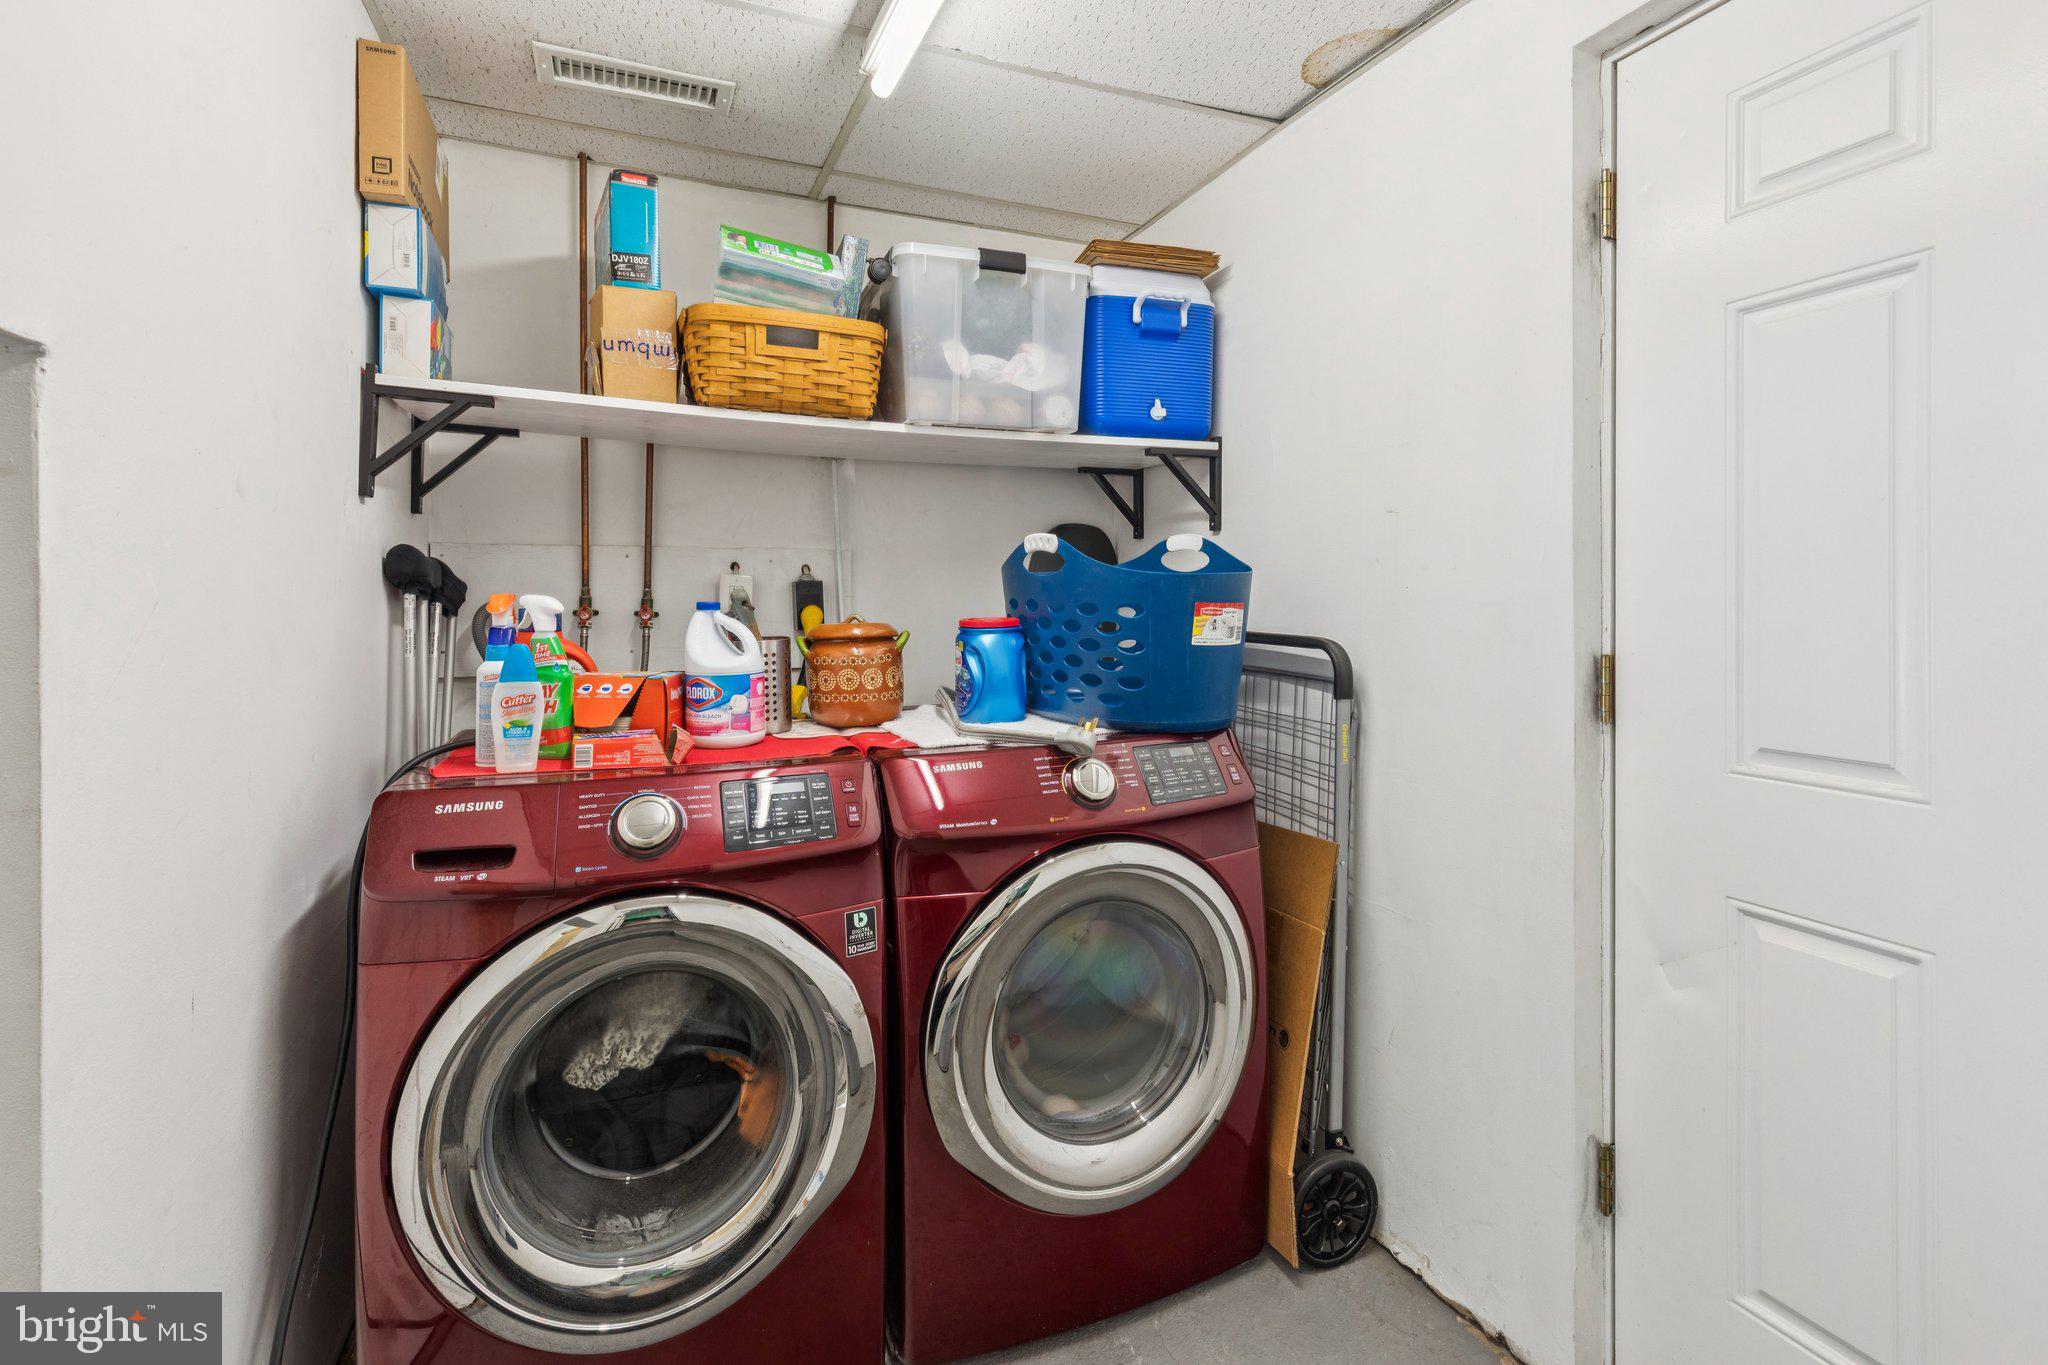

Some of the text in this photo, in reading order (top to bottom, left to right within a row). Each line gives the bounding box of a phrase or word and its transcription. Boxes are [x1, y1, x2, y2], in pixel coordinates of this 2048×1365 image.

[365, 45, 397, 55] SAMSUNG
[611, 253, 649, 265] DJV180Z
[501, 693, 536, 708] Cutter
[933, 760, 983, 773] SAMSUNG
[434, 800, 504, 815] SAMSUNG
[849, 931, 873, 940] INVERTER
[852, 926, 870, 935] DIGITAL
[848, 945, 856, 954] 10
